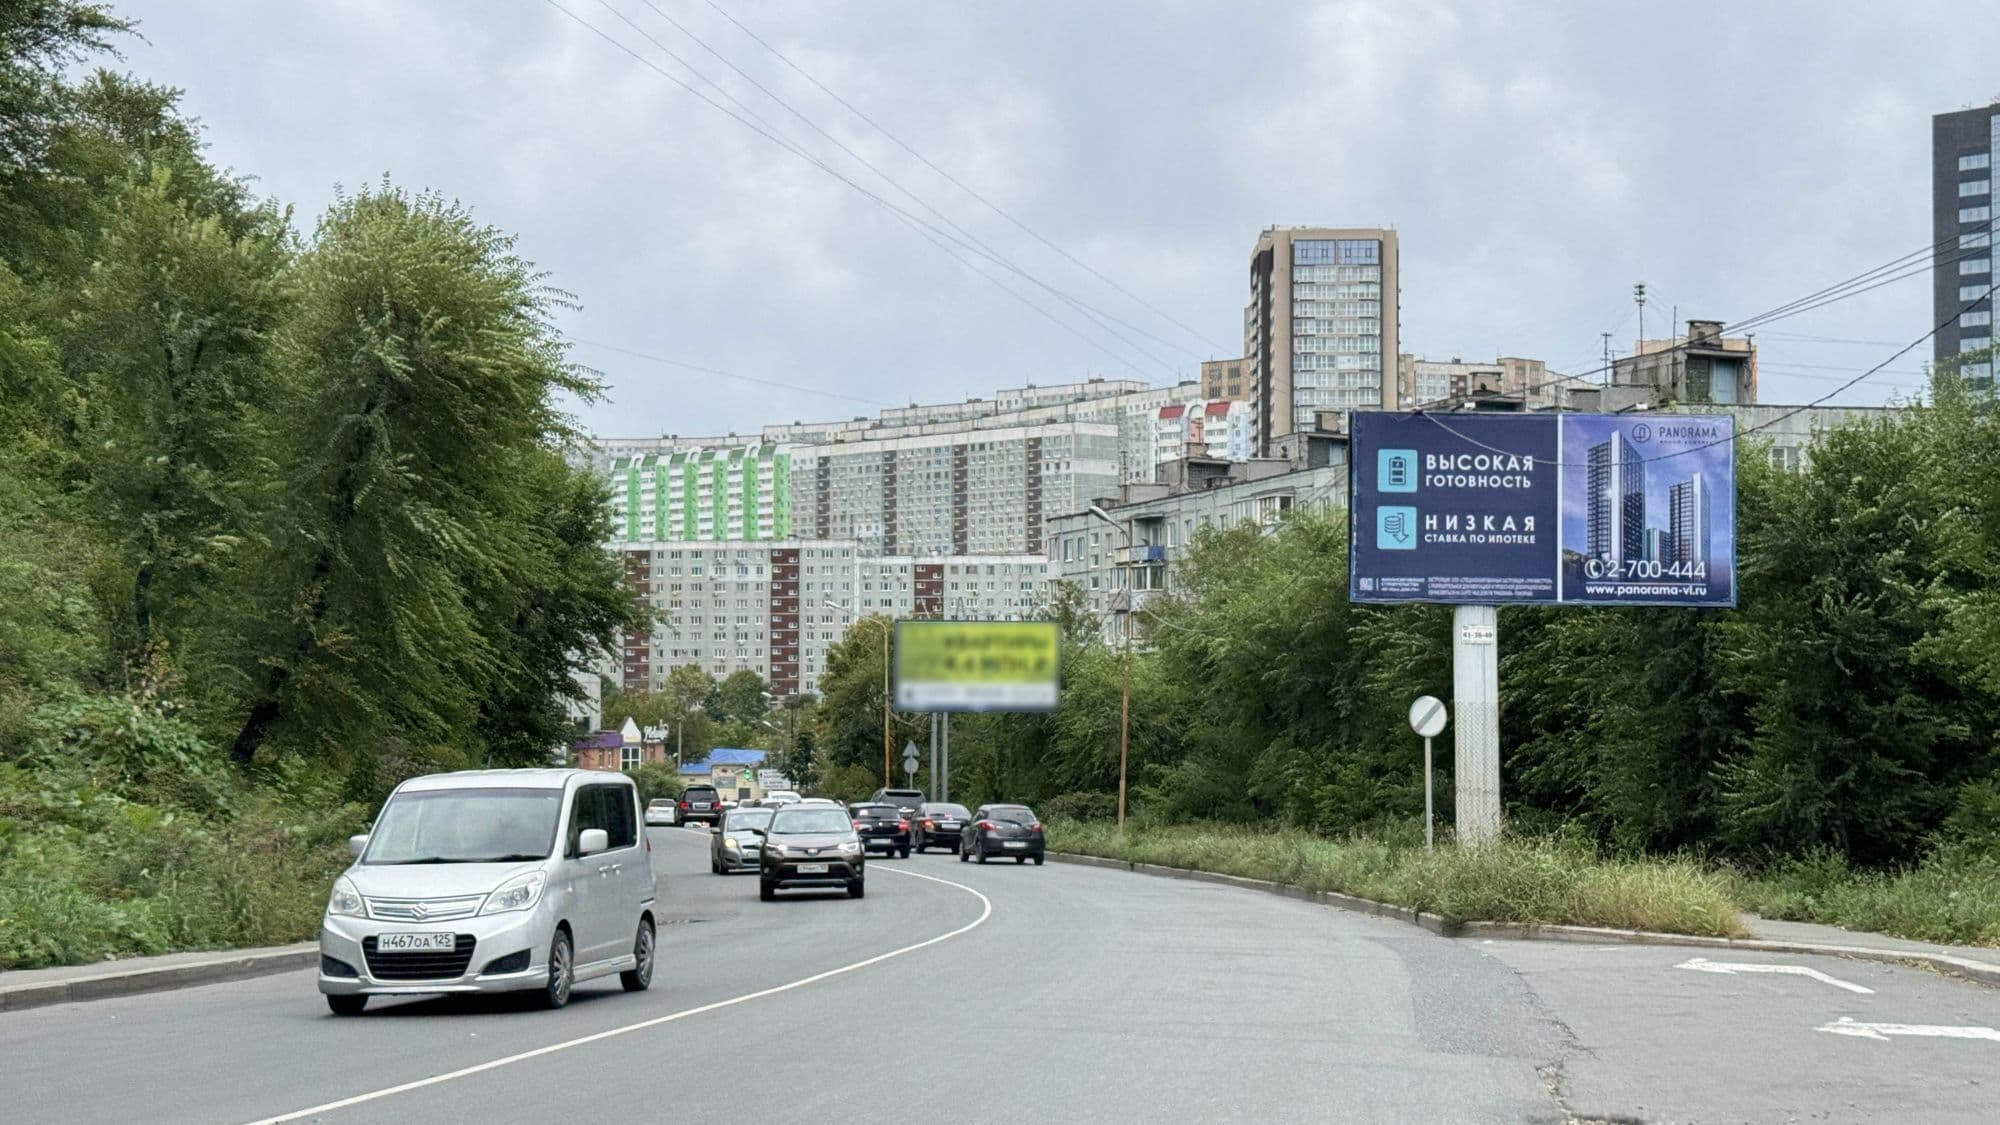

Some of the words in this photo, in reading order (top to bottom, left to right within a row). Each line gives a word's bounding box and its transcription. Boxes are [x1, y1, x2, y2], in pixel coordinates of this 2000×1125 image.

[1659, 426, 1717, 439] PANORAMA
[1426, 454, 1534, 471] ВЫСОКАЯ
[1425, 474, 1532, 488] ГОТОВНОСТЬ
[1425, 514, 1535, 532] НИЗКАЯ
[1424, 533, 1466, 543] СТАВКА
[1469, 534, 1486, 543] ПО
[1488, 534, 1536, 544] ИПОТЕКЕ
[1606, 559, 1706, 579] 2-700-444
[1585, 584, 1707, 596] www.panorama-vl.ru
[433, 933, 452, 945] 125
